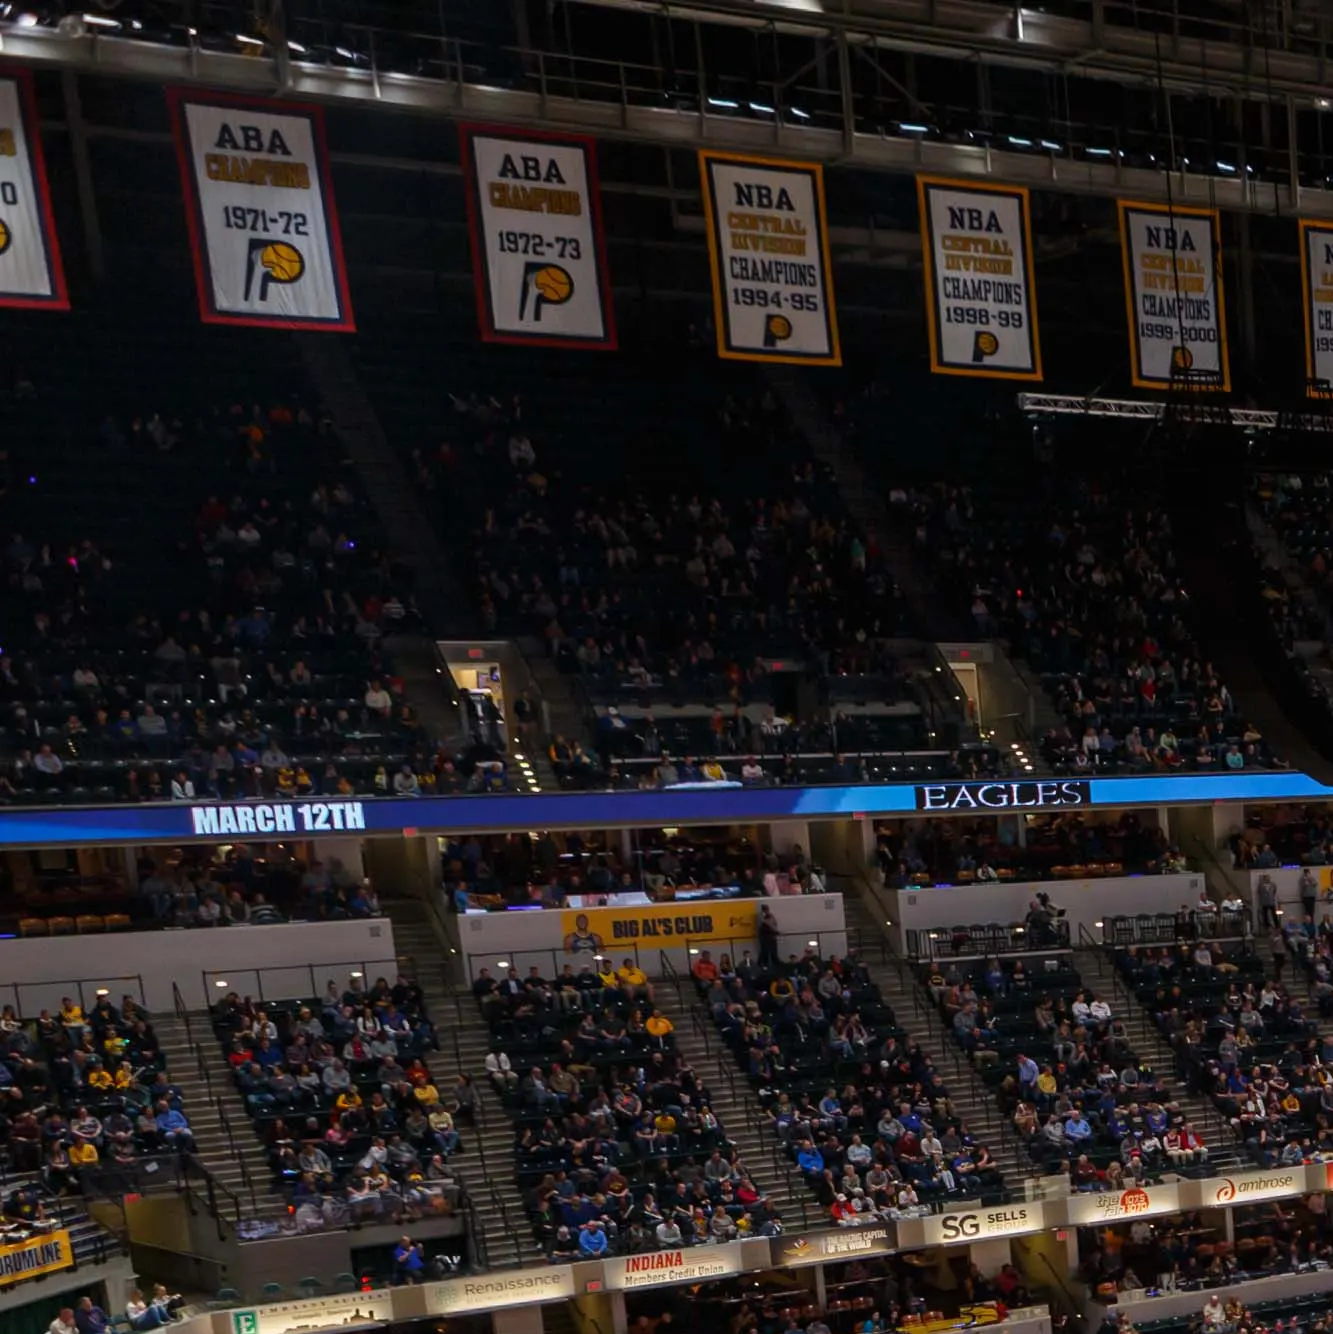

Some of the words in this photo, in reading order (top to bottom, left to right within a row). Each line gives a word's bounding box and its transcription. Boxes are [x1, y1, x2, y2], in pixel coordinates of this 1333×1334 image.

[215, 124, 291, 155] ABA
[205, 153, 310, 189] CHAMPIONS
[499, 155, 566, 184] ABA
[489, 182, 581, 216] CHAMPIONS
[735, 182, 795, 211] NBA
[224, 205, 309, 236] 1971-72
[728, 213, 807, 236] CENTRAL
[948, 207, 1003, 232] NBA
[499, 231, 581, 260] 1972-73
[732, 232, 806, 256] DIVISION
[942, 235, 1013, 257] CENTRAL
[1146, 226, 1195, 250] NBA
[730, 257, 816, 287] CHAMPIONS
[945, 254, 1013, 275] DIVISION
[1141, 252, 1204, 273] CENTRAL
[733, 288, 818, 311] 1994-95
[943, 277, 1021, 305] CHAMPIONS
[946, 307, 1022, 328] 1998-99
[1142, 294, 1210, 321] CHAMPIONS
[1141, 323, 1217, 342] 1999-2000
[923, 782, 1081, 809] EAGLES
[192, 804, 297, 834] MARCH
[298, 802, 366, 831] 12TH
[612, 920, 639, 938] BIG
[642, 917, 674, 936] AL'S
[675, 915, 713, 934] CLUB
[1238, 1175, 1292, 1195] ambrose
[942, 1214, 980, 1239] SG
[987, 1209, 1027, 1223] SELLS
[626, 1251, 683, 1273] INDIANA
[464, 1273, 561, 1295] Renaissance
[625, 1272, 666, 1286] Members
[669, 1268, 695, 1280] Credit
[699, 1265, 724, 1276] Union
